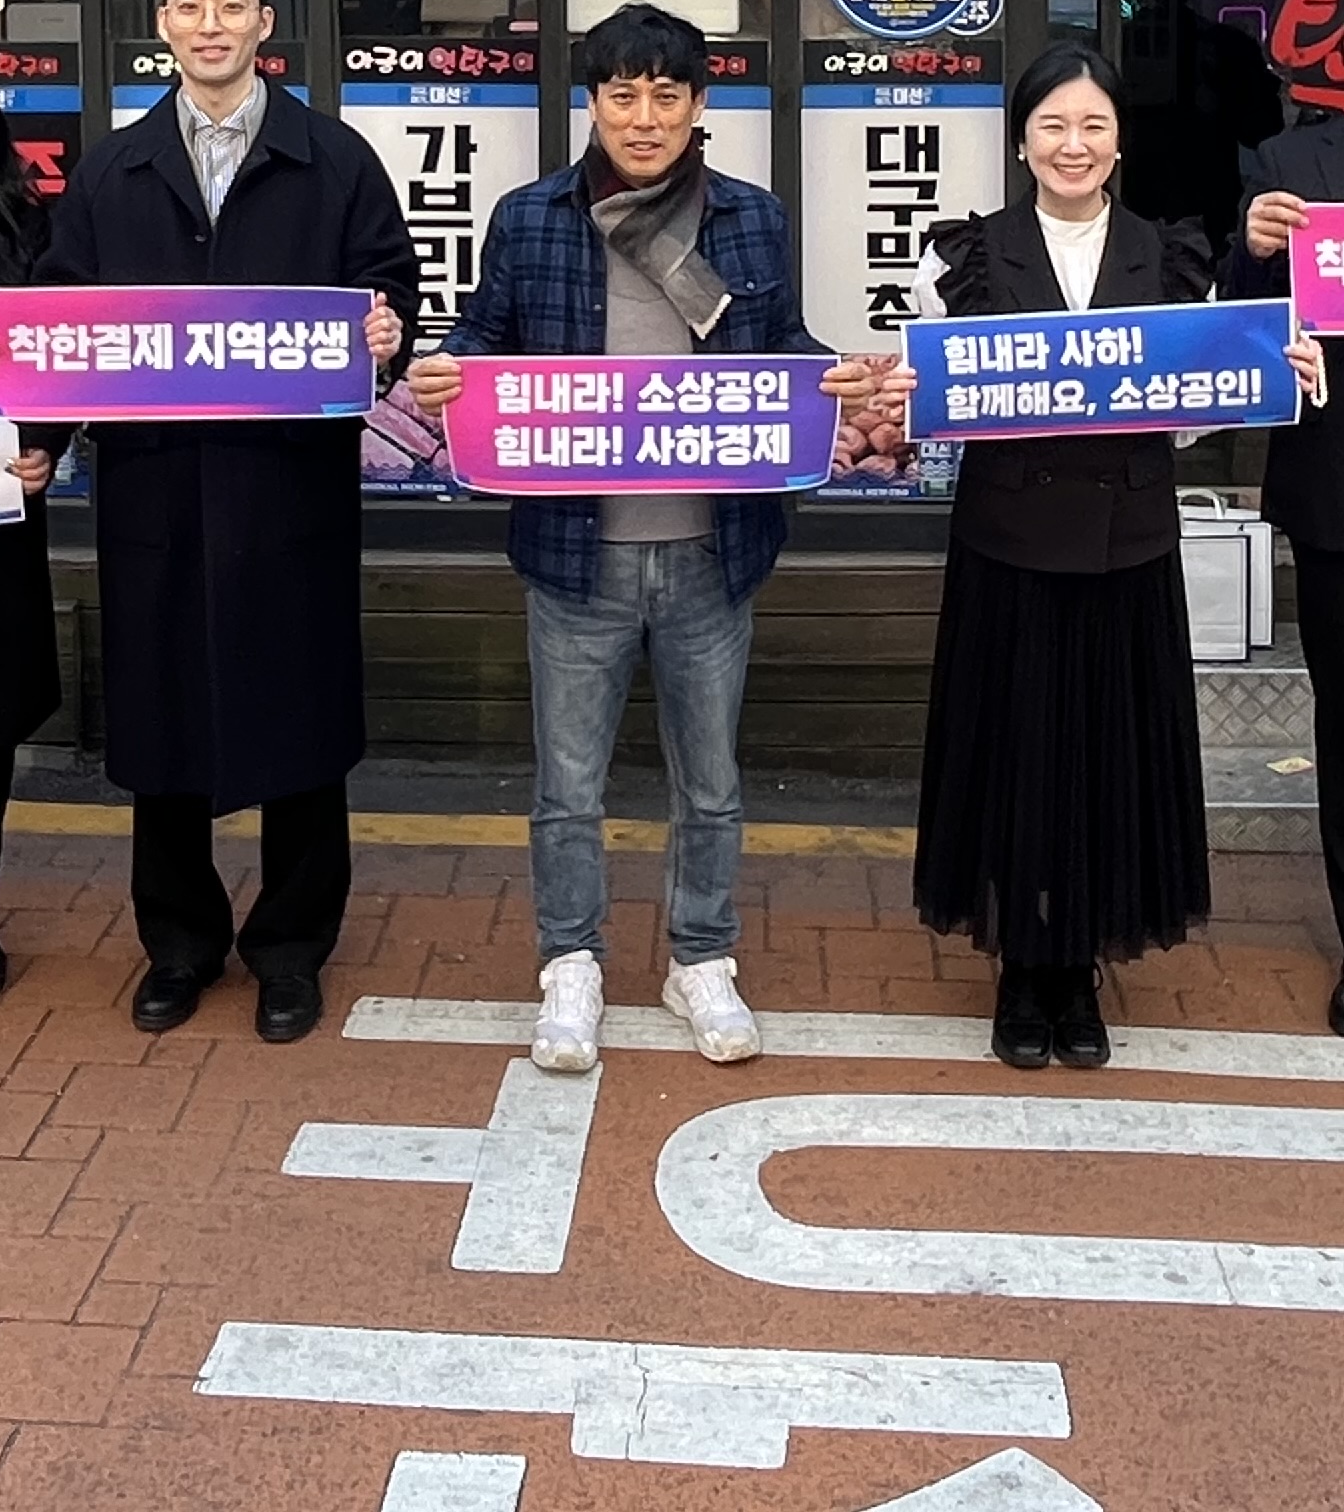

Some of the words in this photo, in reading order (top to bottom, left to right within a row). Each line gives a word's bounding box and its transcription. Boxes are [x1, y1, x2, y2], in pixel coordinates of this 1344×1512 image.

[133, 53, 182, 76] 아궁
[346, 46, 424, 73] 아궁이
[824, 52, 888, 75] 아궁이
[8, 320, 174, 372] 착한결제
[184, 320, 351, 371] 지역상생
[943, 331, 1051, 375] 힘내라
[1059, 326, 1144, 369] 사하!
[493, 371, 624, 415] 힘내라!
[636, 370, 791, 413] 소상공인
[945, 380, 1097, 421] 함께해요,
[1108, 368, 1263, 413] 소상공인!
[493, 424, 624, 468] 힘내라!
[635, 423, 791, 467] 사하경제
